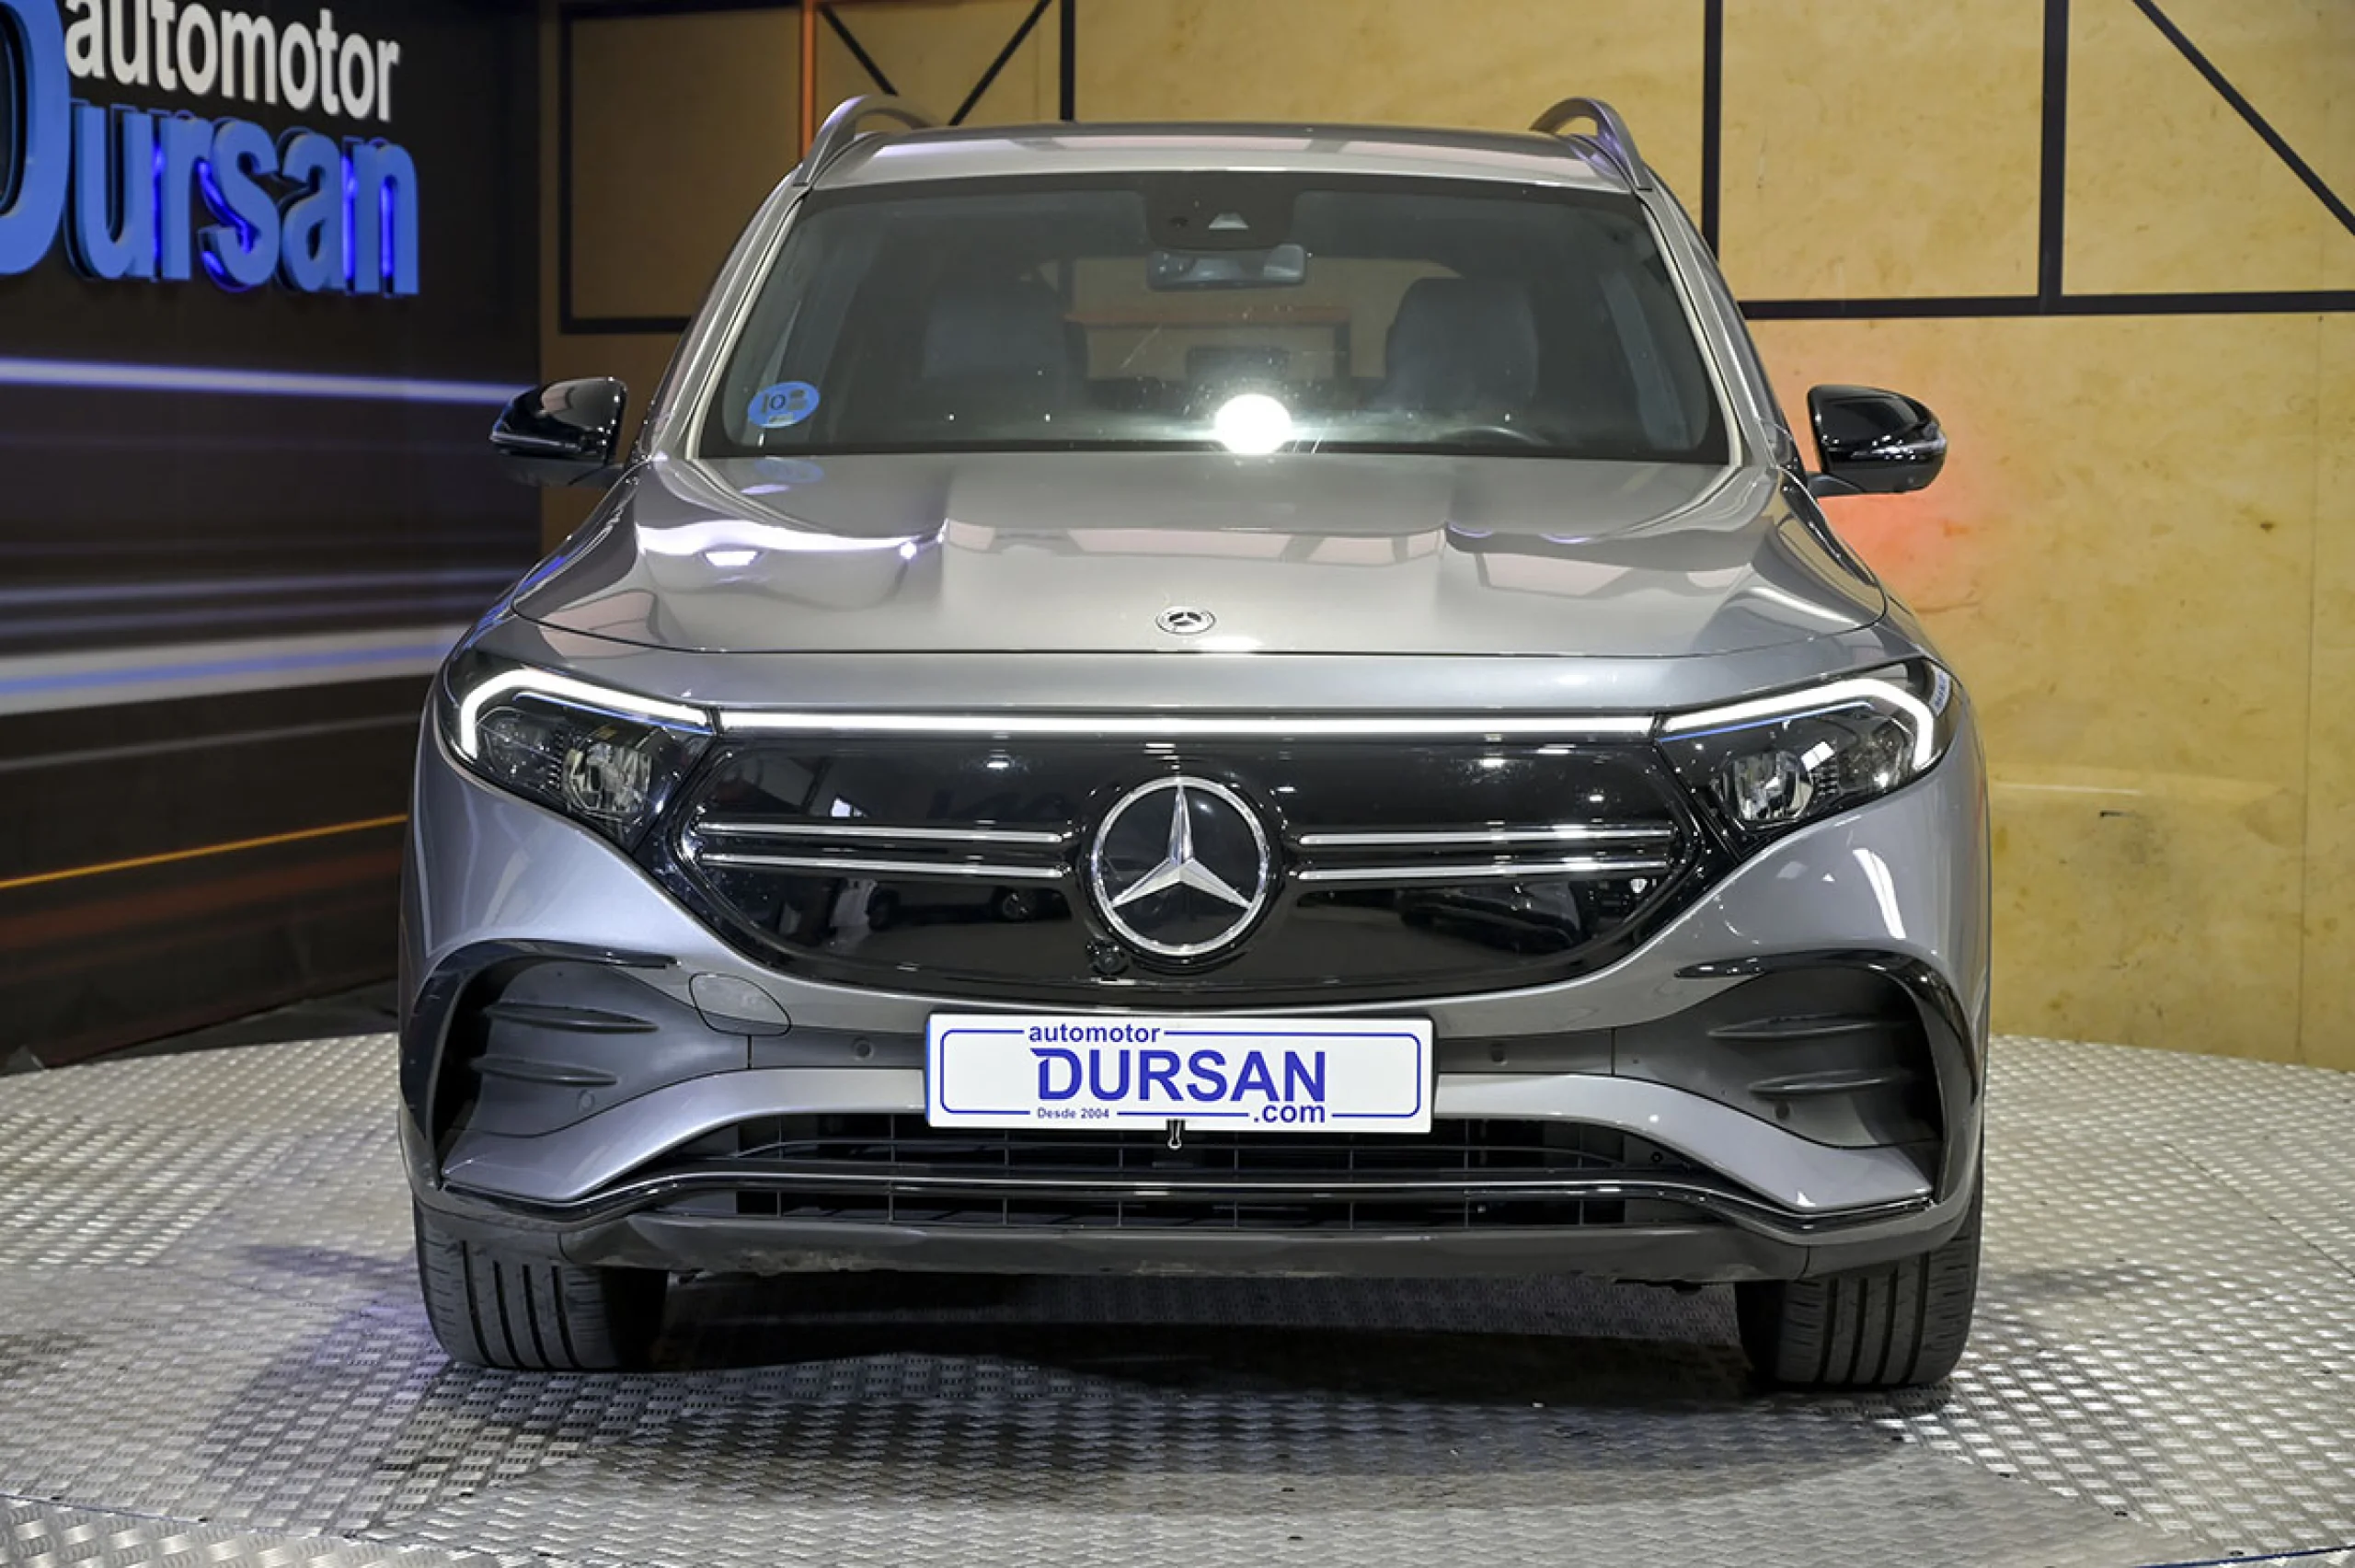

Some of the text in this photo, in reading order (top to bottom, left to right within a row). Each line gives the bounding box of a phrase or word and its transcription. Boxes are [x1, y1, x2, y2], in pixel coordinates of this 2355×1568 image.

[64, 0, 400, 121] automotor
[1028, 1023, 1161, 1043] automotor
[1029, 1047, 1326, 1103] DURSAN
[1037, 1107, 1109, 1119] Desde 2004
[1253, 1104, 1326, 1123] .com
